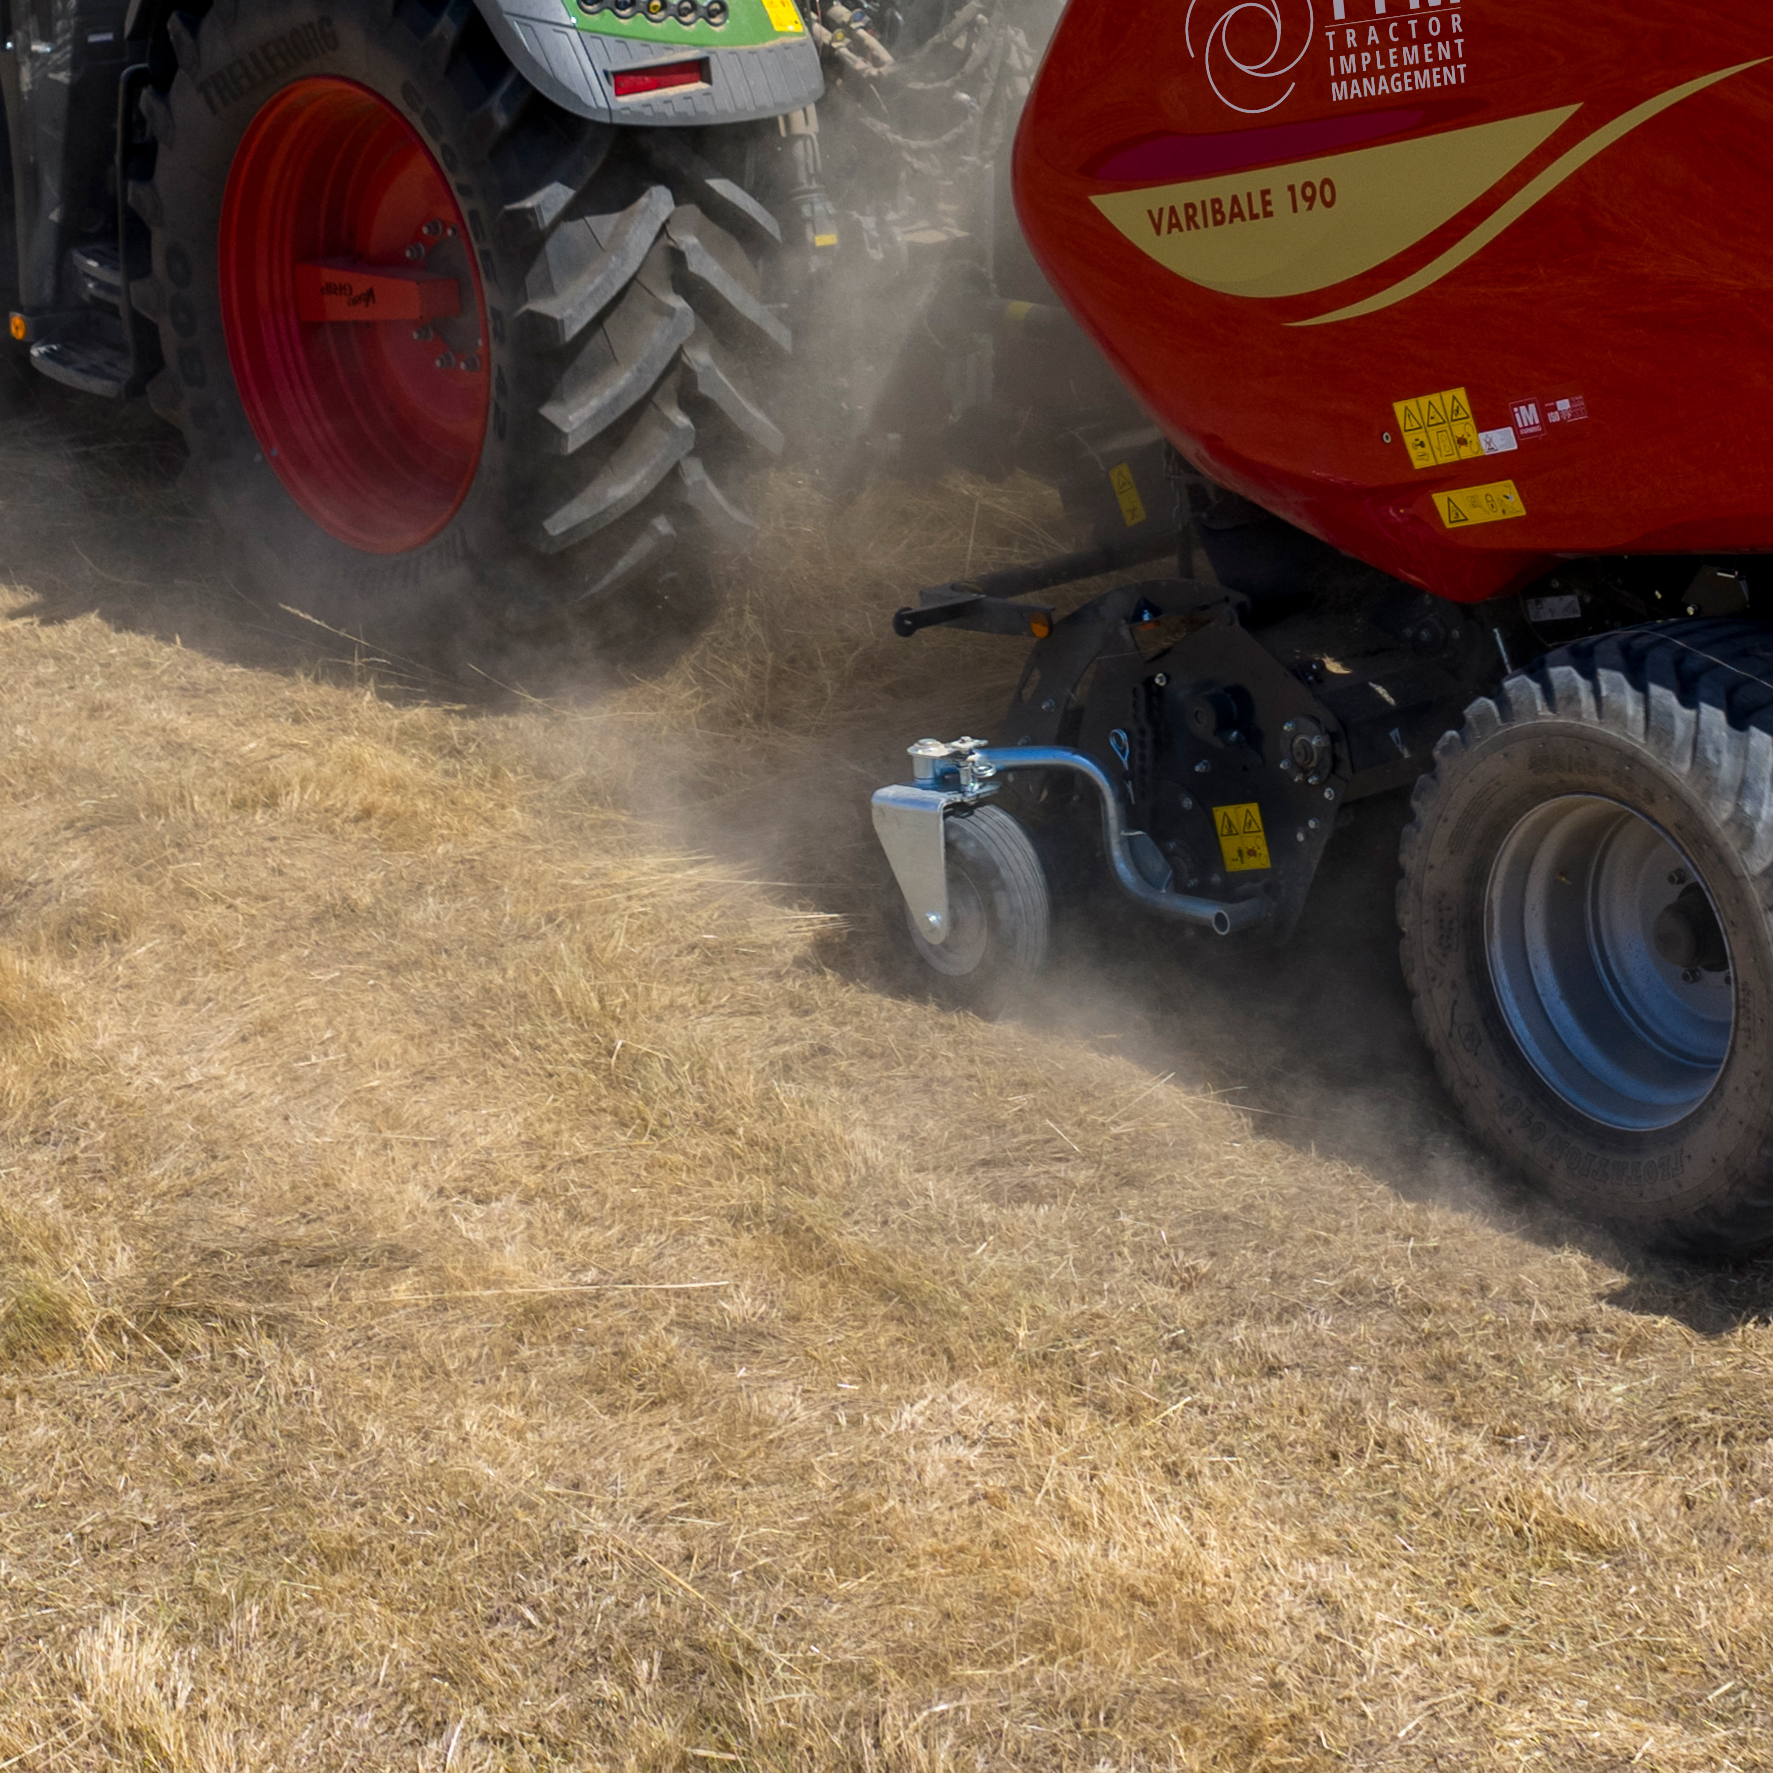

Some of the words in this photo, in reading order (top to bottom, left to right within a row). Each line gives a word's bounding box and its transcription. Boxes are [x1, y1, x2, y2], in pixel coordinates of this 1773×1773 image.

[1325, 14, 1463, 50] TRACTOR
[196, 13, 339, 115] TRELLEBORG
[1329, 38, 1465, 76] IMPLEMENT
[1331, 64, 1467, 101] MANAGEMENT
[1147, 188, 1274, 237] VARIBALE
[1287, 177, 1337, 215] 190
[1544, 1133, 1685, 1187] FLOTATION
